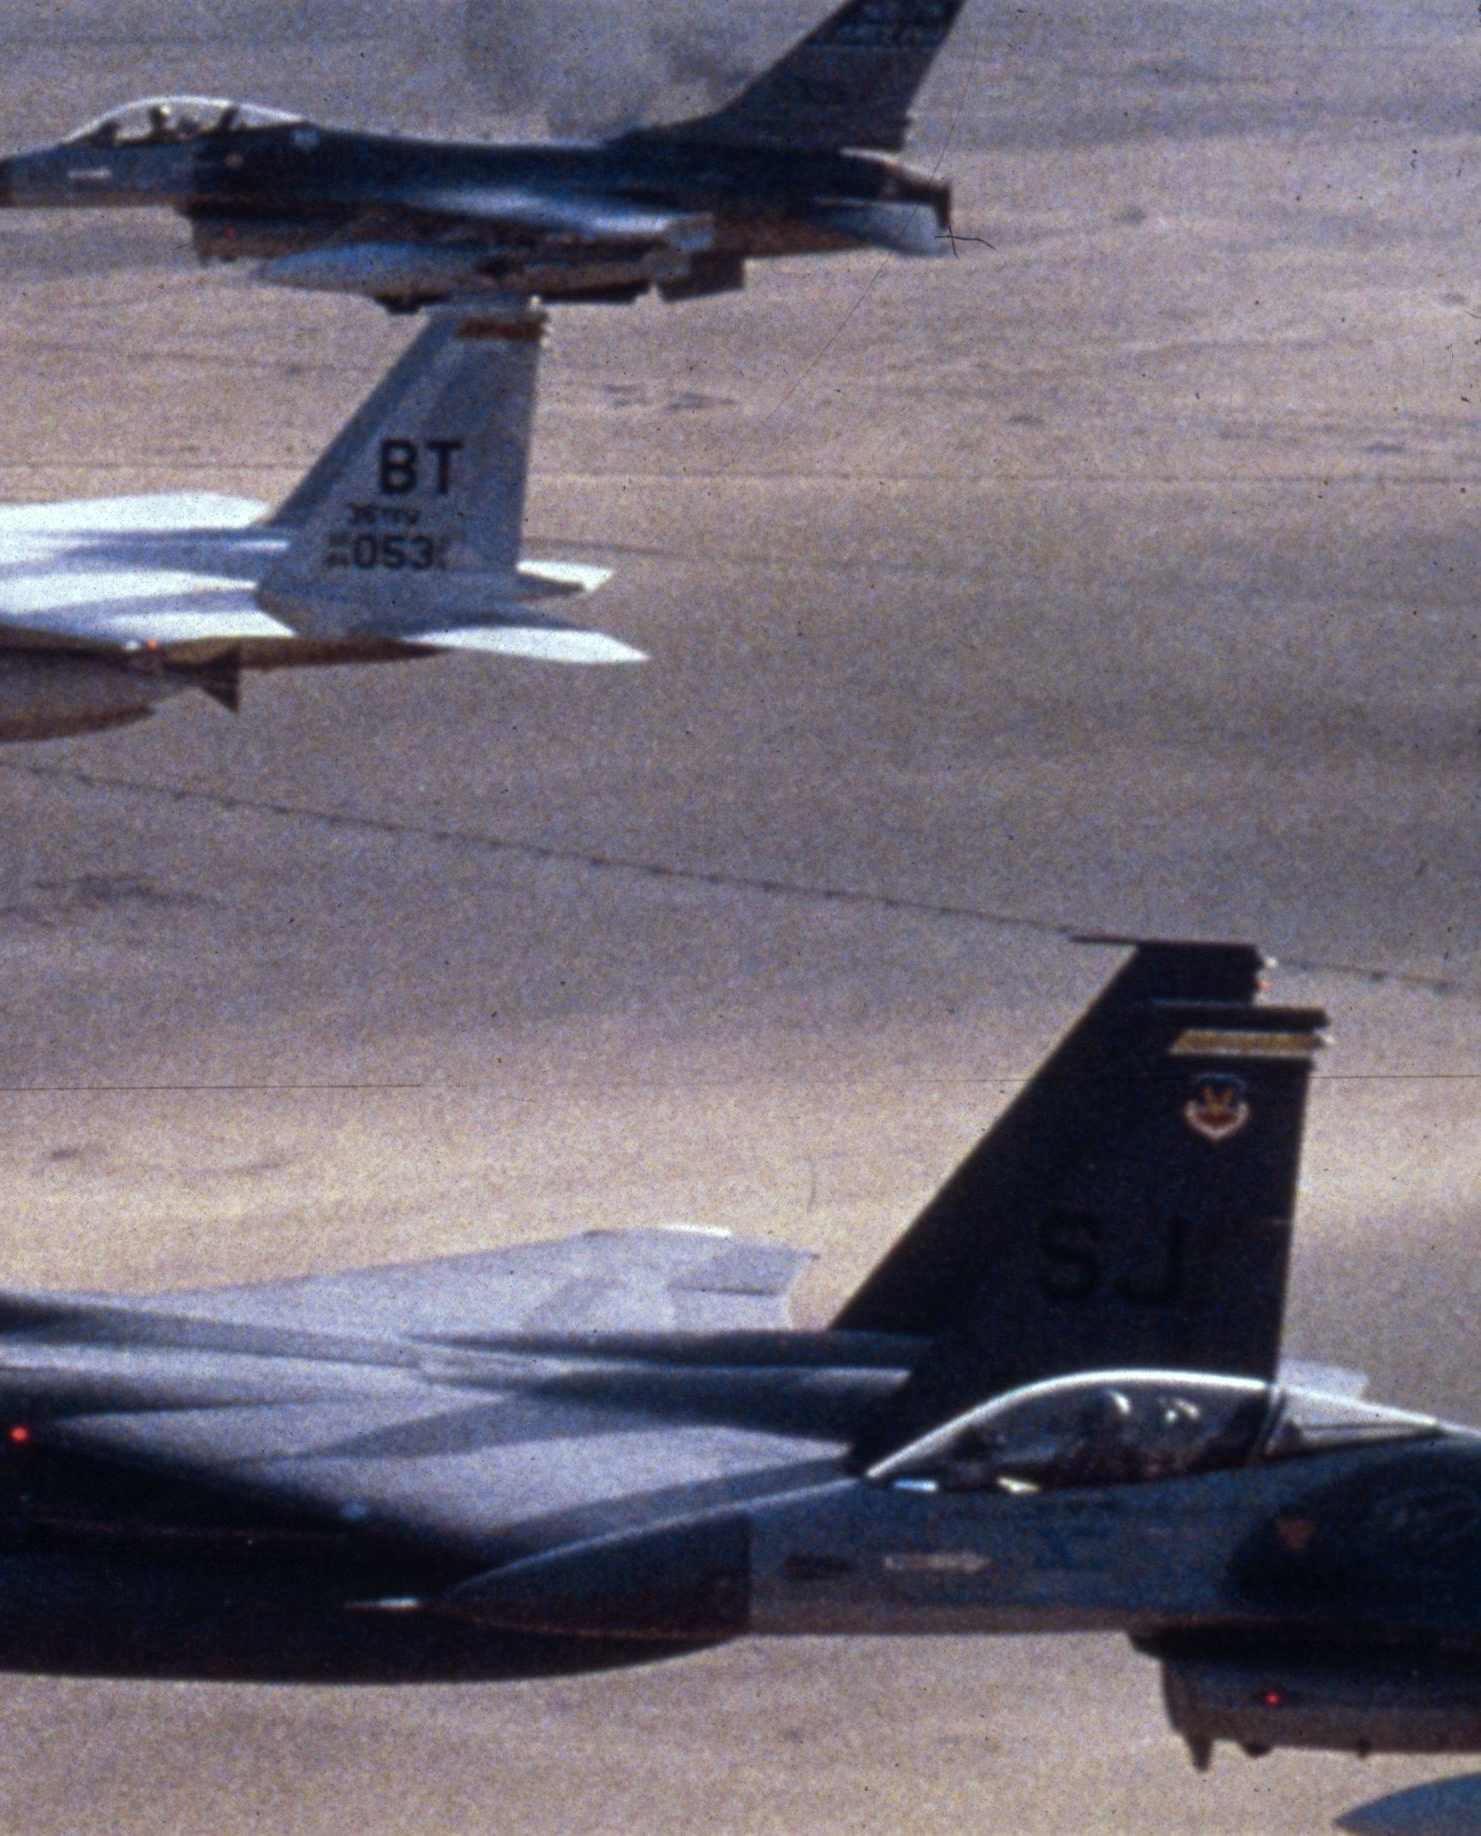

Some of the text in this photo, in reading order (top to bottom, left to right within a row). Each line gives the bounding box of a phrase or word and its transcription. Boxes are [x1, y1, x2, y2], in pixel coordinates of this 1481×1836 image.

[380, 438, 463, 495] BT
[353, 533, 434, 570] 053
[1040, 1211, 1185, 1303] SJ
